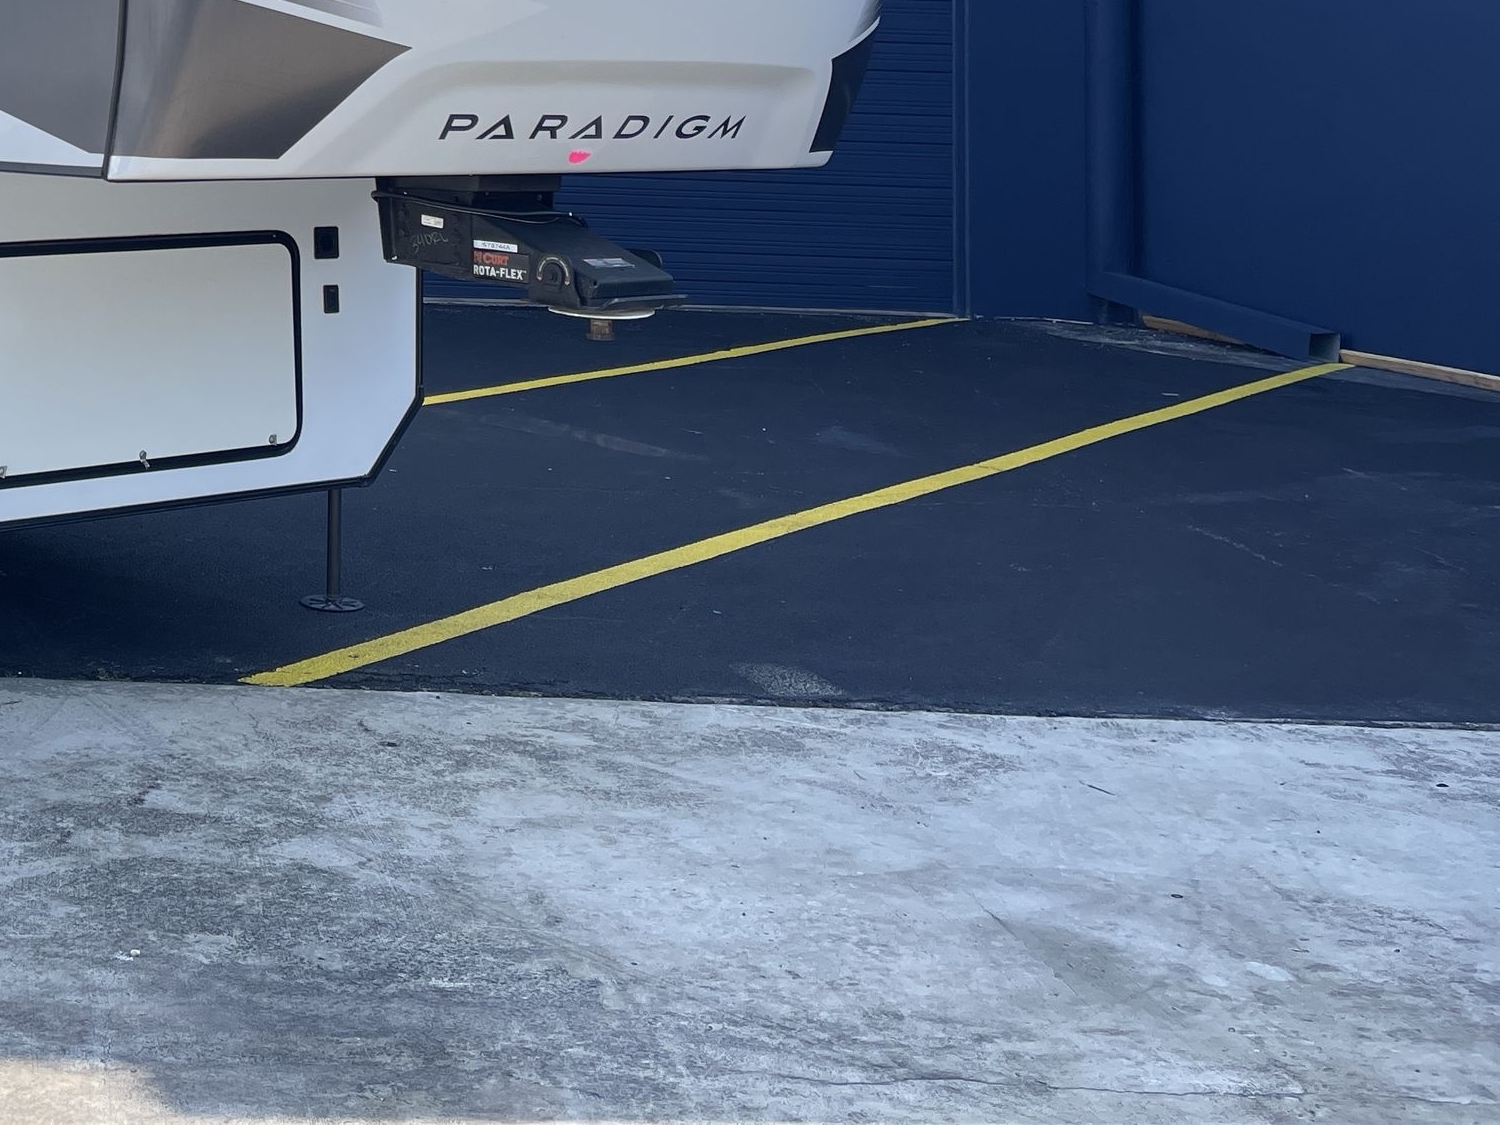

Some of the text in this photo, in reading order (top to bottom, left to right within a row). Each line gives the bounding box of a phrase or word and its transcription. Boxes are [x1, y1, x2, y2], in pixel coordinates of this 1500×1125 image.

[438, 114, 747, 140] PARADIGM
[483, 252, 509, 266] CURT
[473, 264, 524, 280] ROTA-FLEX
